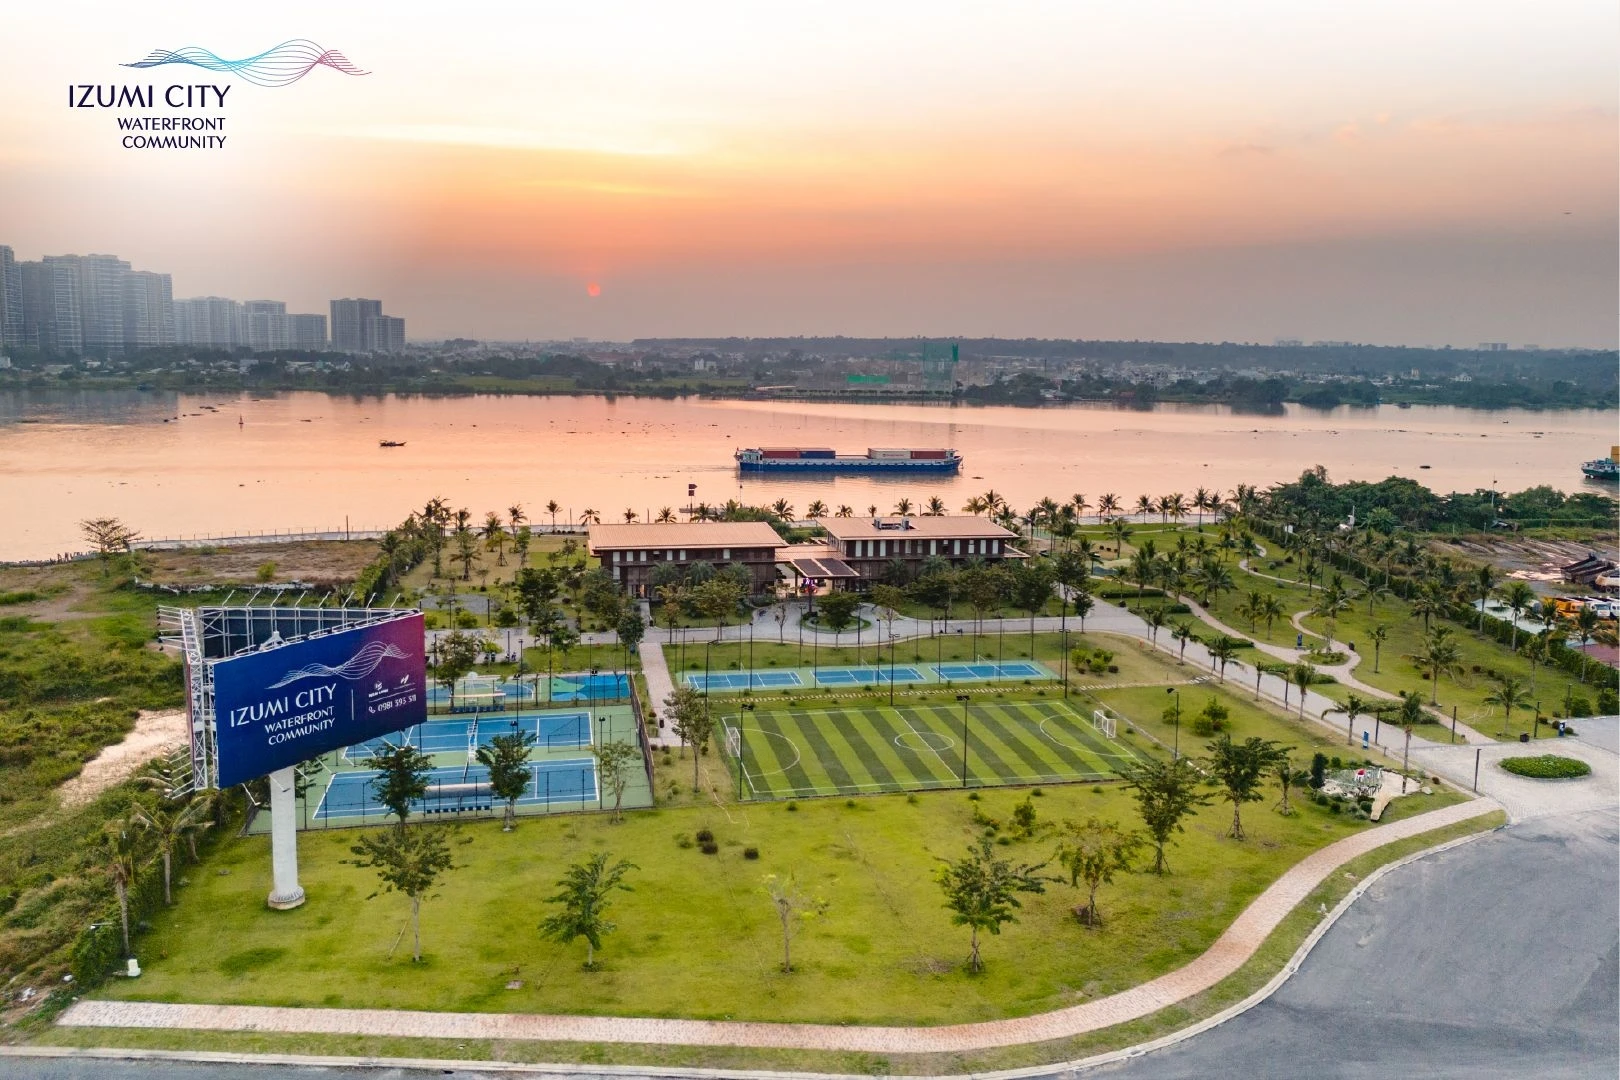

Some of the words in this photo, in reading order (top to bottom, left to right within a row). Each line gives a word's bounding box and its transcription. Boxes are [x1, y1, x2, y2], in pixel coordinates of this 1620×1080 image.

[230, 696, 289, 728] IZUMI
[295, 683, 337, 708] CITY
[264, 706, 335, 733] WATERFRONT
[268, 718, 336, 746] COMMUNITY
